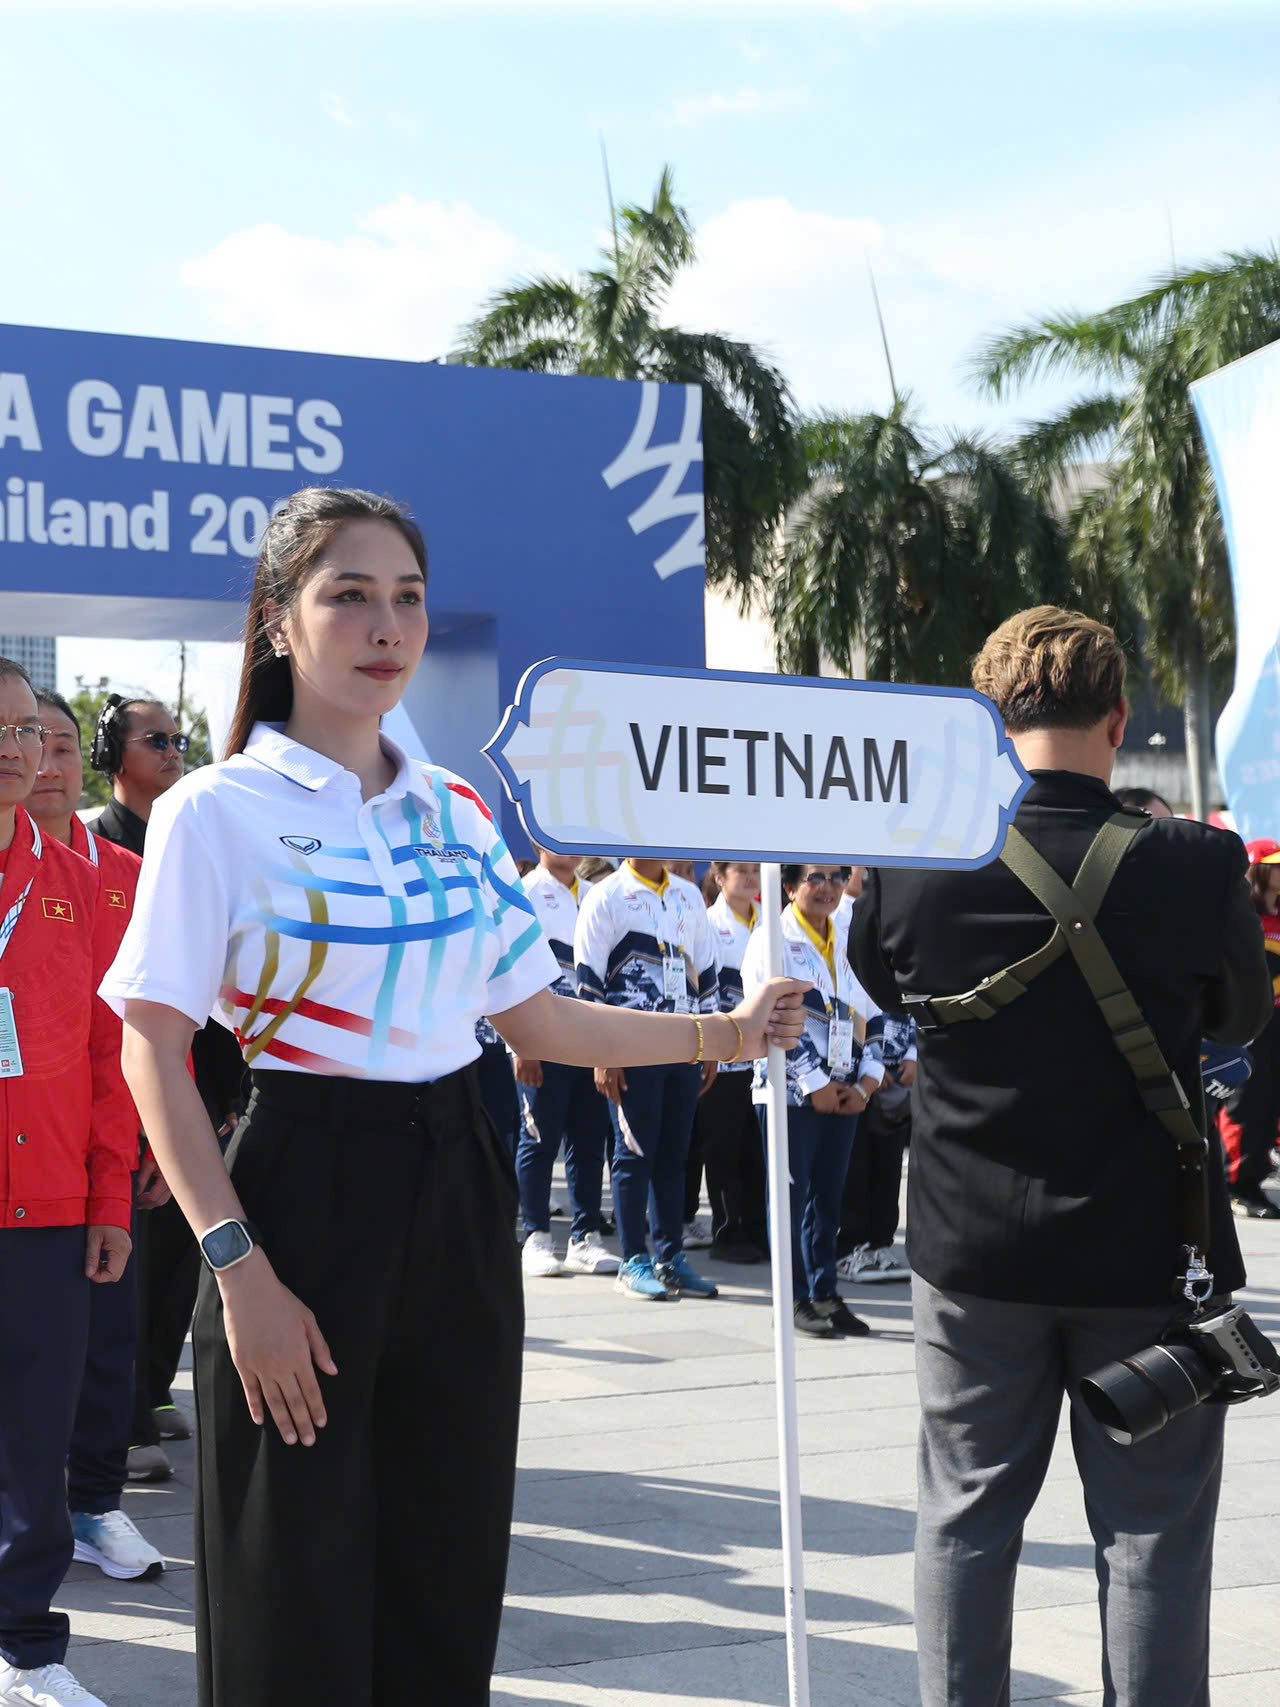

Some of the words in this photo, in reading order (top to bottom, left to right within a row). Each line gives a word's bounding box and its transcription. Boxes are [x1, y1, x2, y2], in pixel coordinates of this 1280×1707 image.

[67, 379, 344, 474] GAMES
[189, 492, 290, 558] 20
[628, 722, 908, 805] VIETNAM
[415, 847, 469, 860] THAILAND
